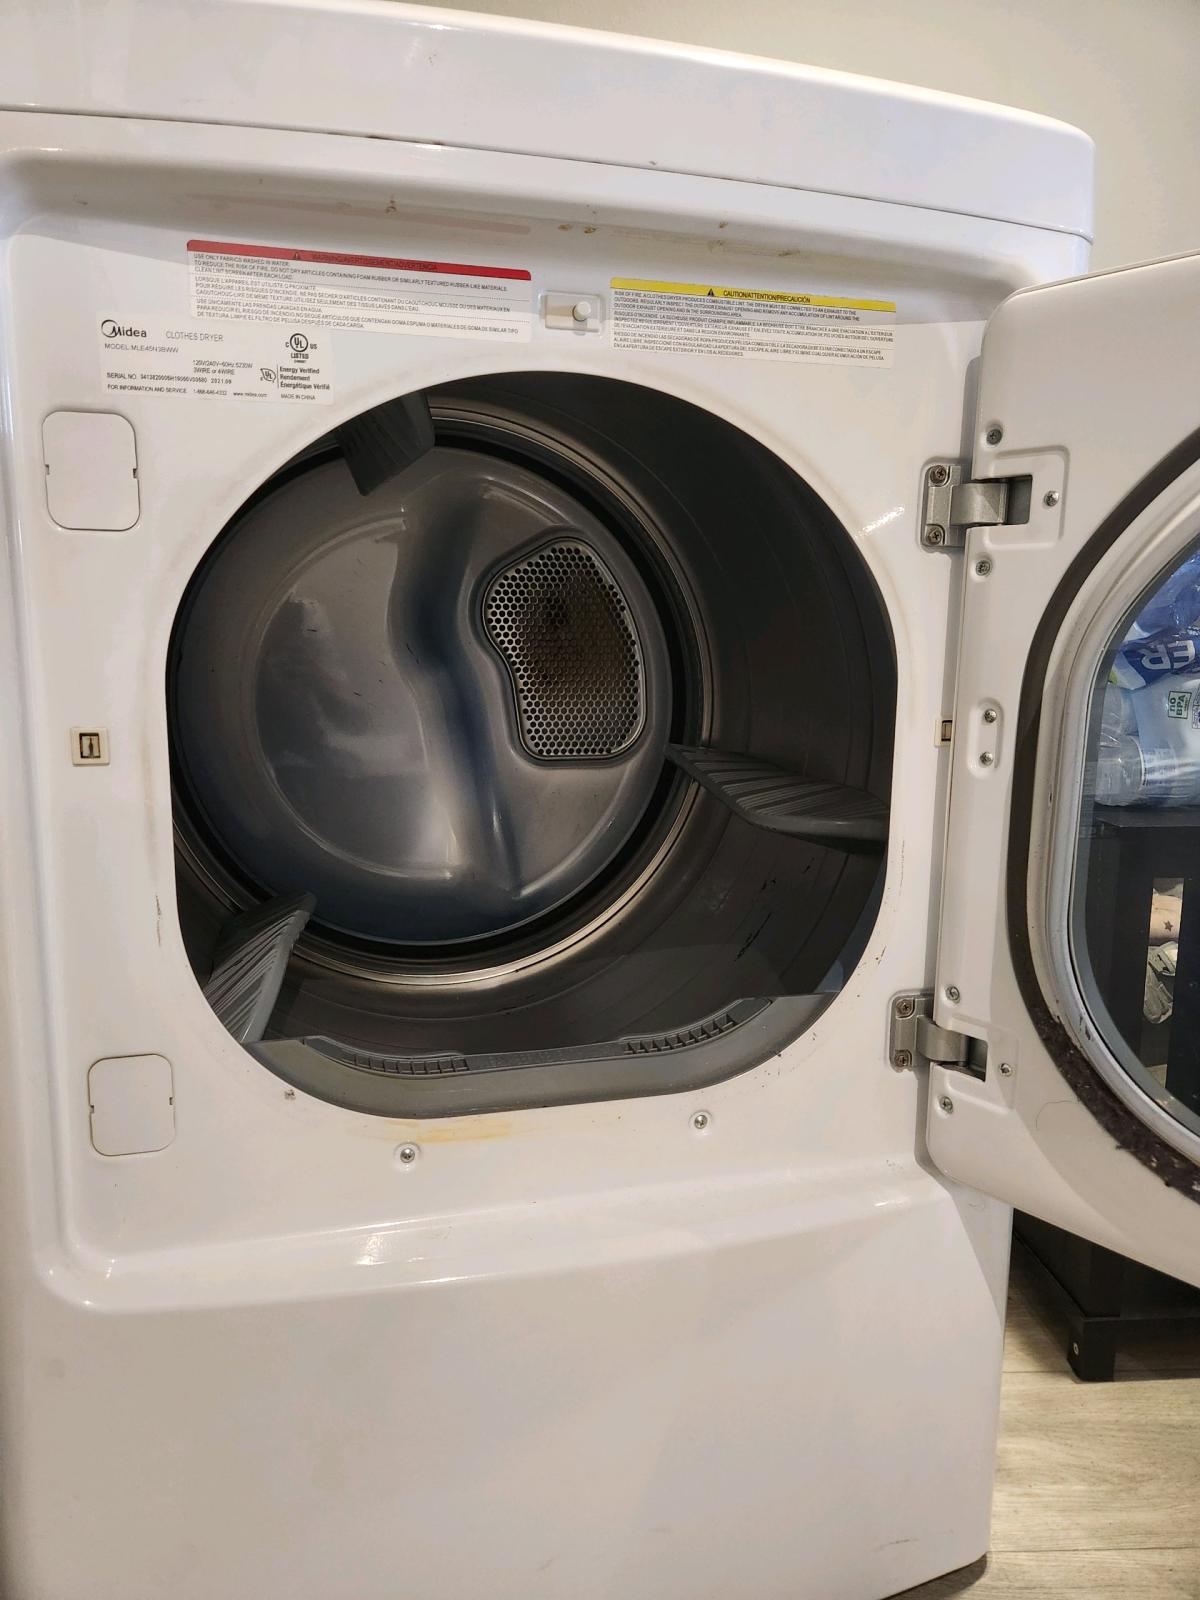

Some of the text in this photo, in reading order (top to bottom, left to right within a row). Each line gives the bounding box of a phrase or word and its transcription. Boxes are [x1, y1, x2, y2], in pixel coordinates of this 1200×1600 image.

[101, 318, 147, 338] Midea
[165, 330, 223, 342] CLOTHES DRYER
[279, 373, 310, 381] Rendement
[119, 384, 153, 392] INFORMATION
